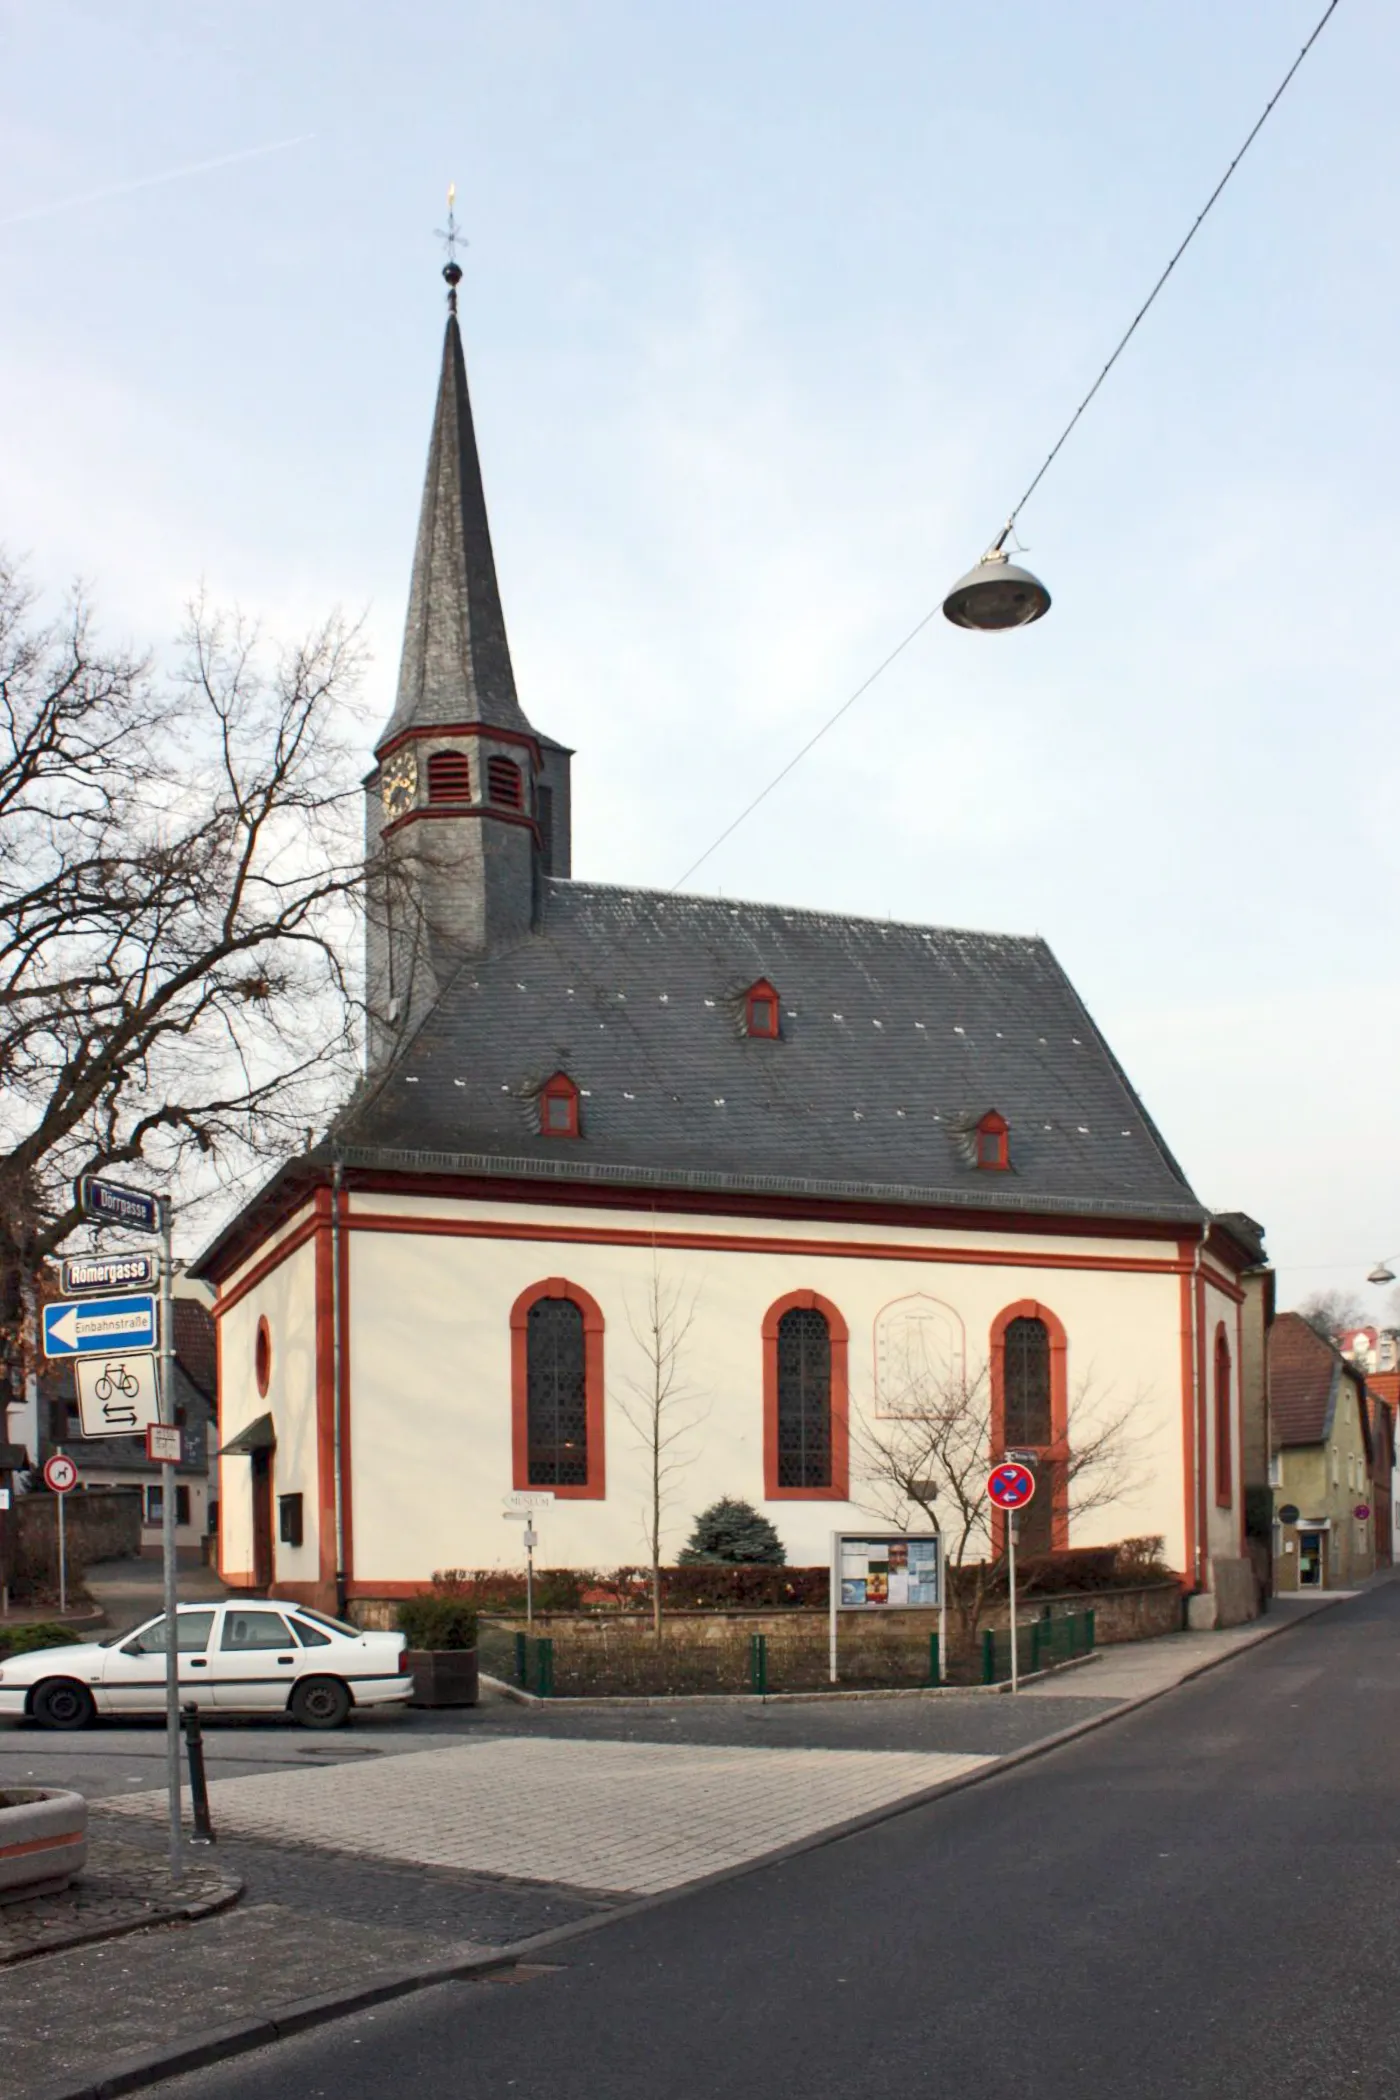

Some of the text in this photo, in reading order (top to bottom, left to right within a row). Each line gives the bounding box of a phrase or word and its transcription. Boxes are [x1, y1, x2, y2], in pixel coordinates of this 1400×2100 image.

[101, 1188, 147, 1218] Dörrgasse
[71, 1261, 145, 1284] Römergasse
[75, 1316, 148, 1334] Einbahnstraße
[510, 1497, 549, 1507] MUSEUM
